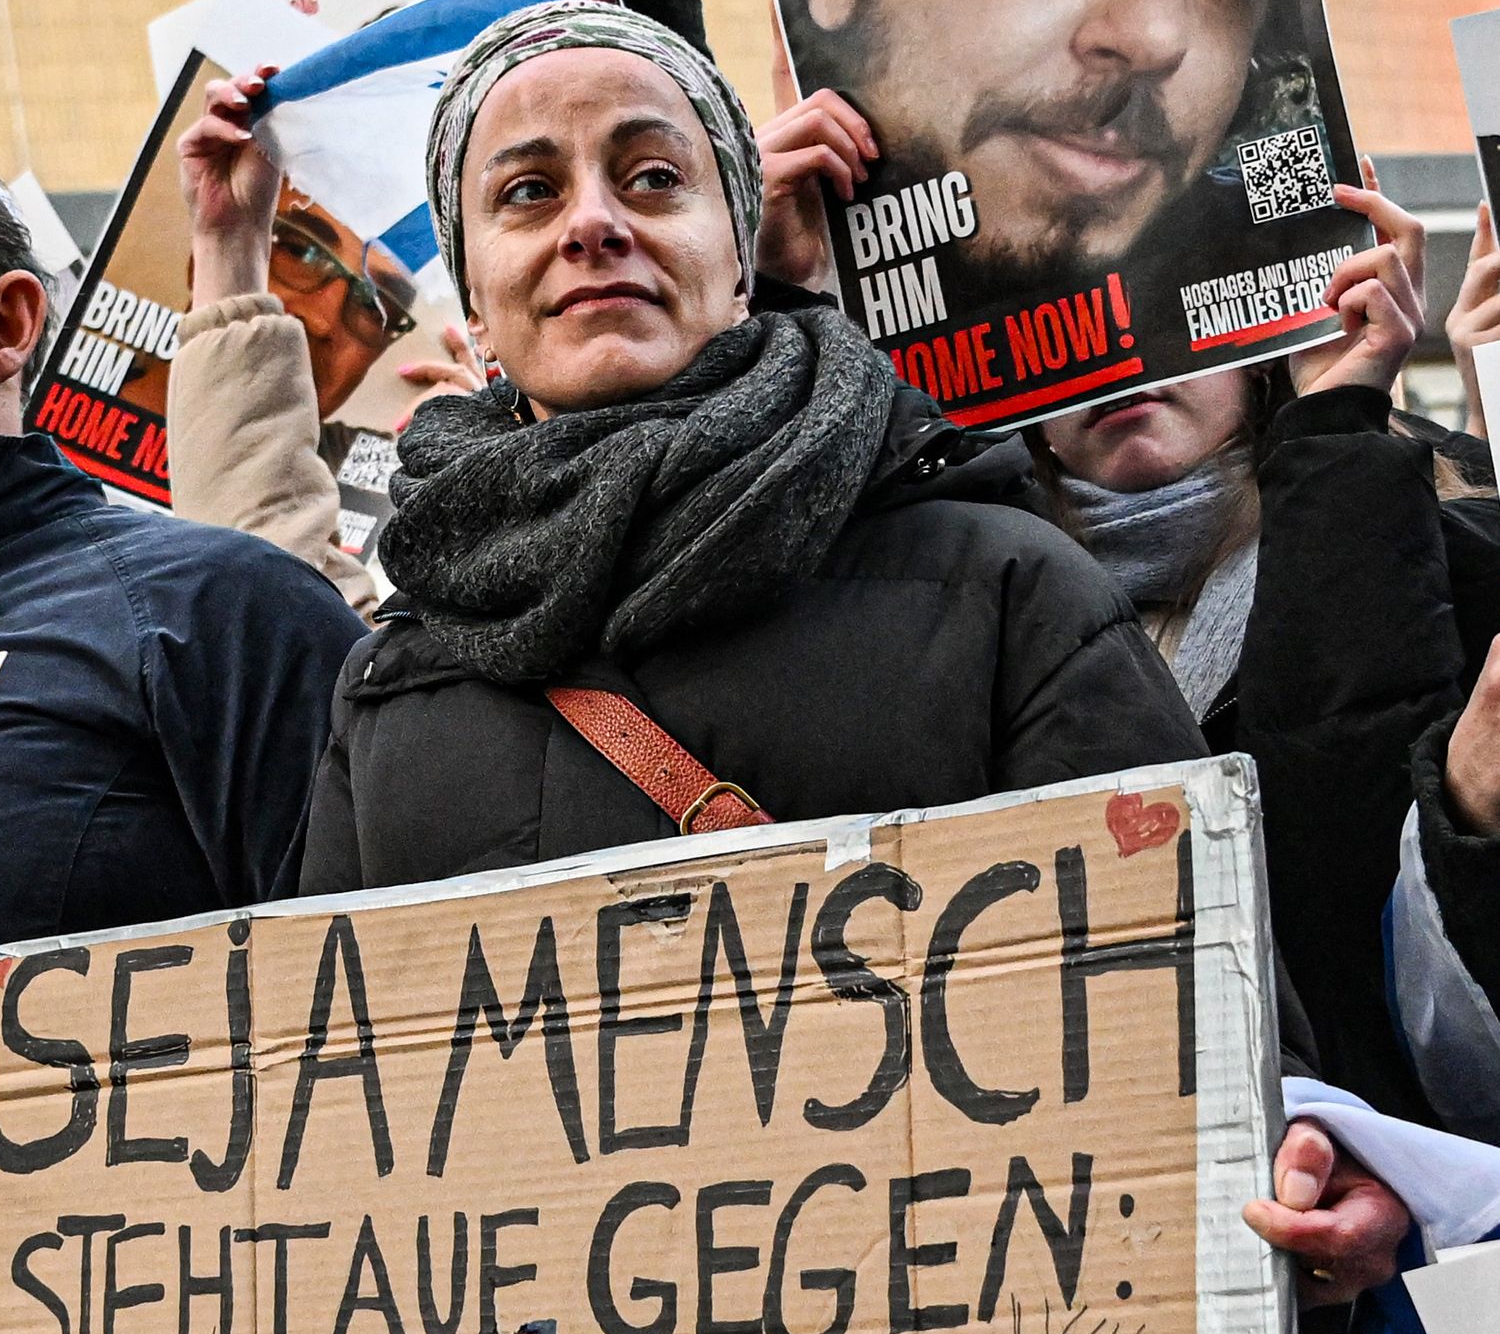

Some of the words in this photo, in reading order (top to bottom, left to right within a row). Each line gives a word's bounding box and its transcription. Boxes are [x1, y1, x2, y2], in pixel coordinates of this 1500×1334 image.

[845, 170, 976, 269] BRING
[82, 281, 184, 360] BRING
[859, 256, 948, 341] HIM
[1180, 270, 1256, 310] HOSTAGES
[1257, 263, 1288, 291] AND
[1186, 289, 1283, 341] FAMILIES
[1284, 274, 1332, 317] FOR
[57, 329, 135, 396] HIM
[1005, 272, 1134, 381] NOW!
[36, 382, 138, 460] HOME
[274, 914, 396, 1193] A
[427, 825, 1199, 1179] MENSCH
